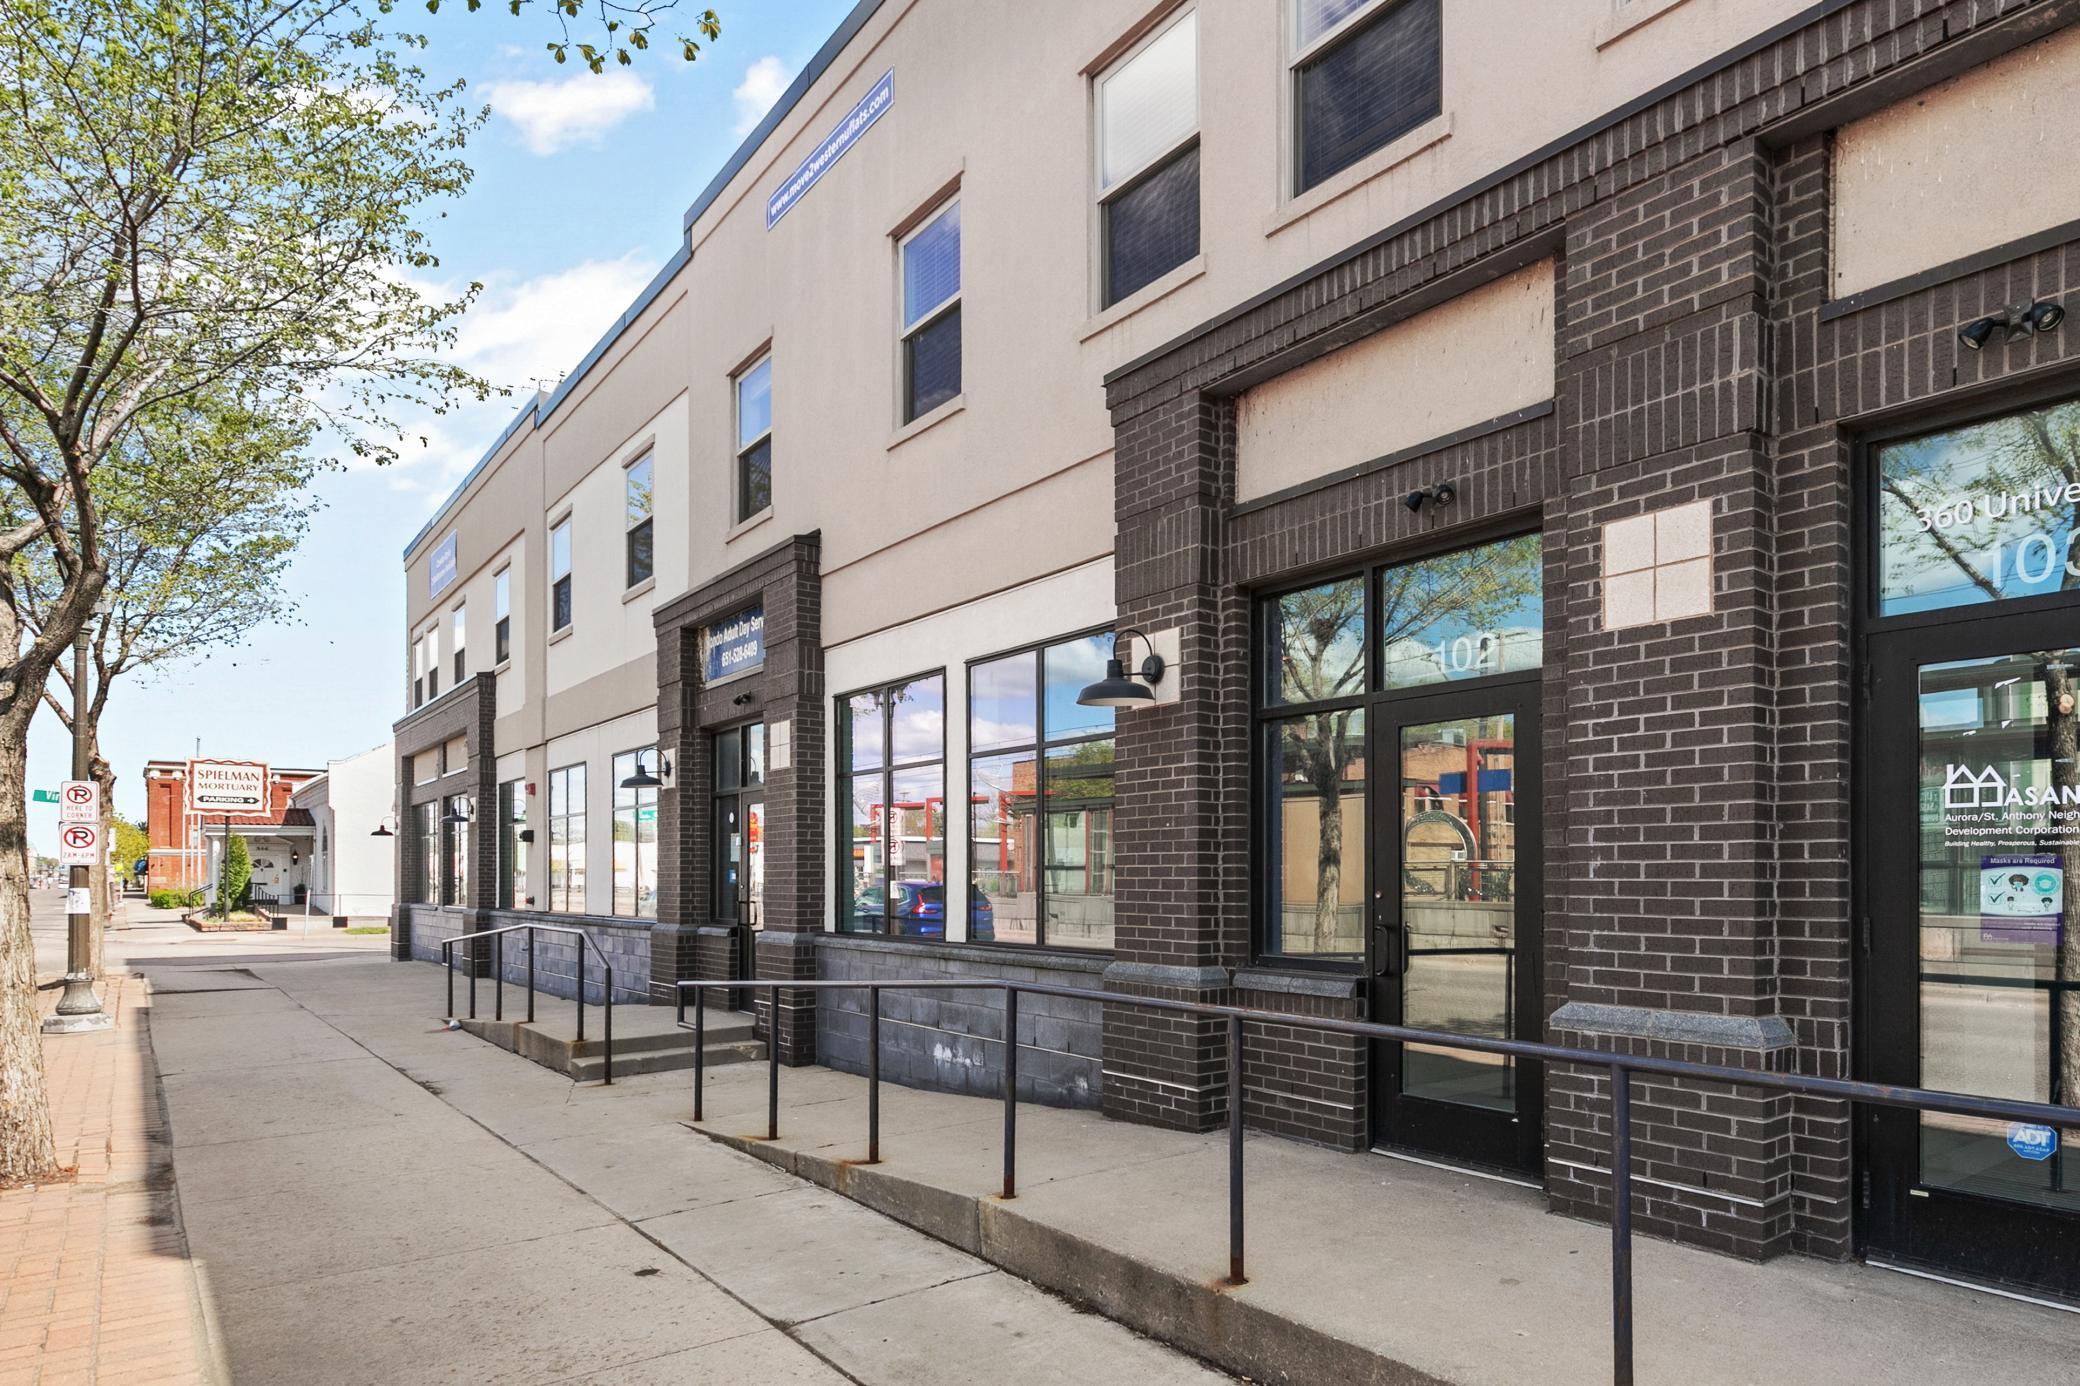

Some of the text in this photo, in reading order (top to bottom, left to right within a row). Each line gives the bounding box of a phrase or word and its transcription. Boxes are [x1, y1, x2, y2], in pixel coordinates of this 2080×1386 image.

[1915, 482, 2080, 532] 360 Unive
[739, 621, 751, 638] Day
[1438, 632, 1497, 672] 102
[197, 769, 260, 782] SPIELMAN
[198, 782, 258, 792] MORTUARY
[202, 795, 244, 803] PARKING
[1945, 810, 2080, 823] Aurora/St. Anthony Neigh
[1945, 825, 2080, 836] Development Corporation
[2024, 857, 2056, 865] Required
[2013, 1128, 2051, 1147] ADT
